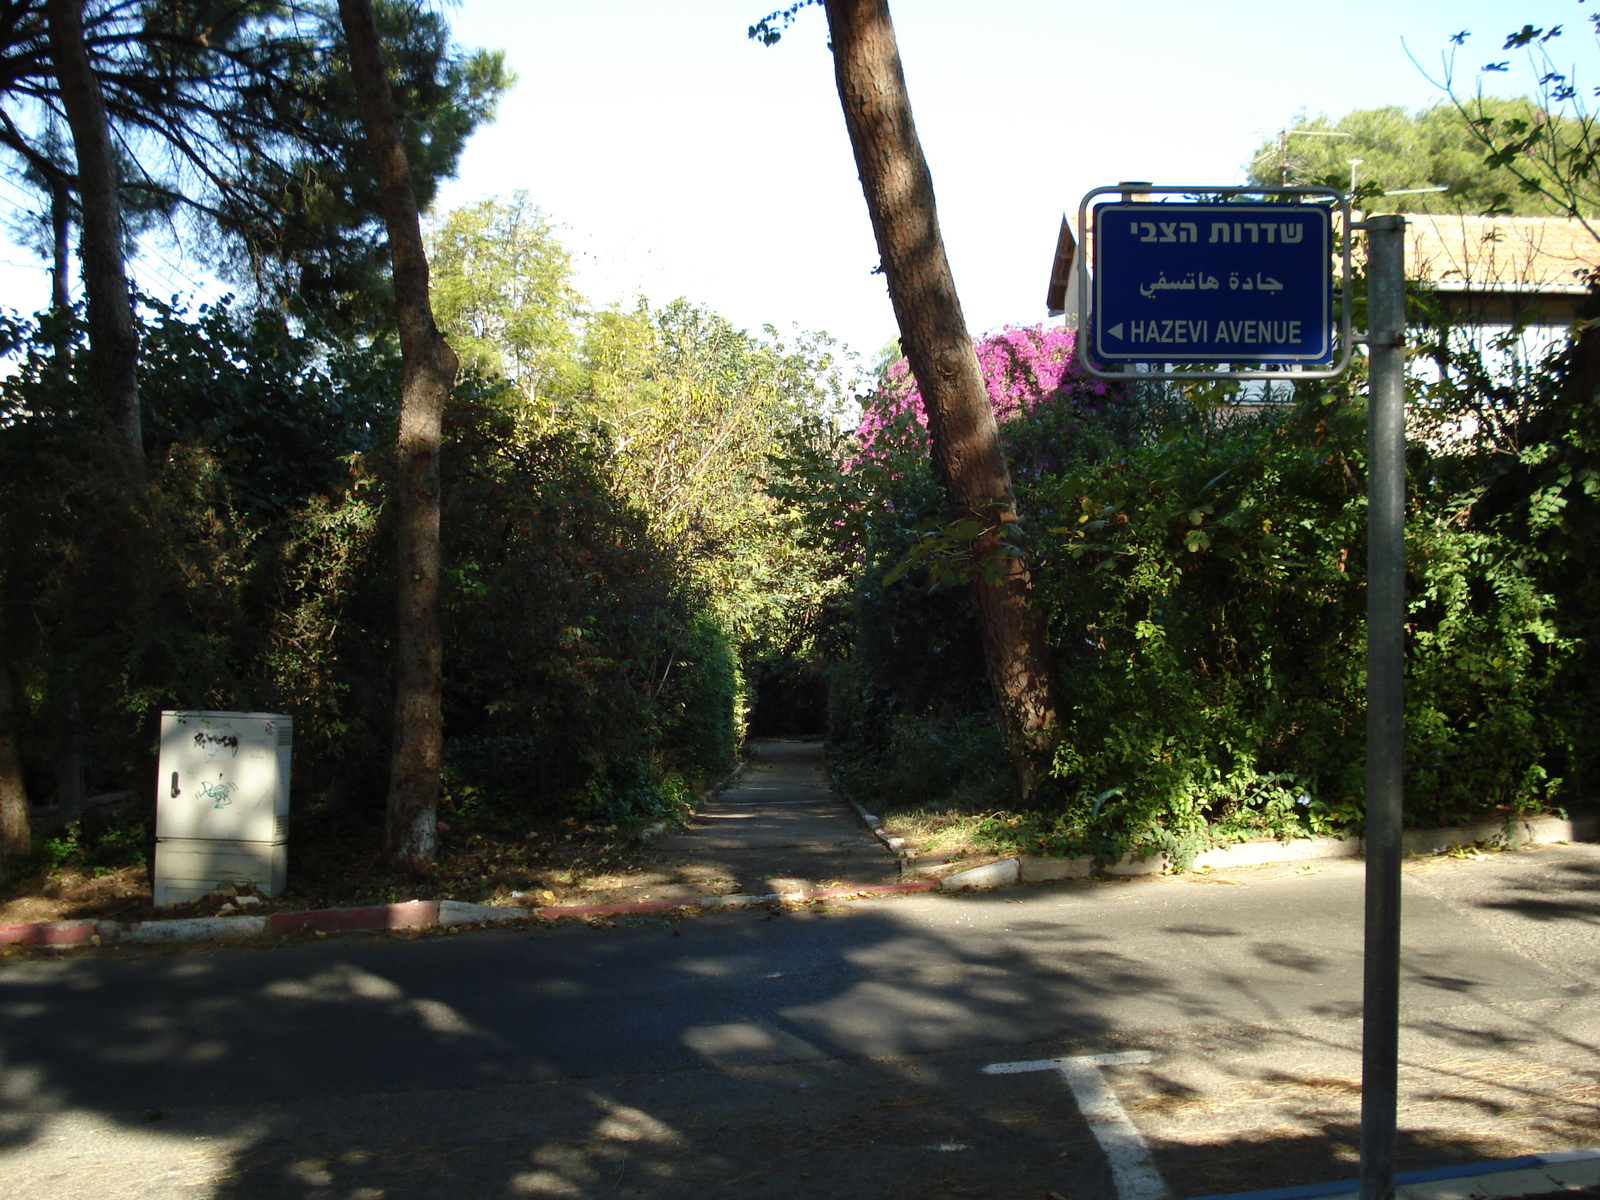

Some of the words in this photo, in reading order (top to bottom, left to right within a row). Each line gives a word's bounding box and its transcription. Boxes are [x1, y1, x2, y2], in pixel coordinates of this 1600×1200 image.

[1130, 221, 1198, 243] הצבי
[1208, 222, 1304, 244] שדרות
[1139, 271, 1220, 299] هاتسفي
[1229, 271, 1284, 295] جادة
[1130, 320, 1208, 344] HAZEVI
[1214, 320, 1303, 344] AVENUE
